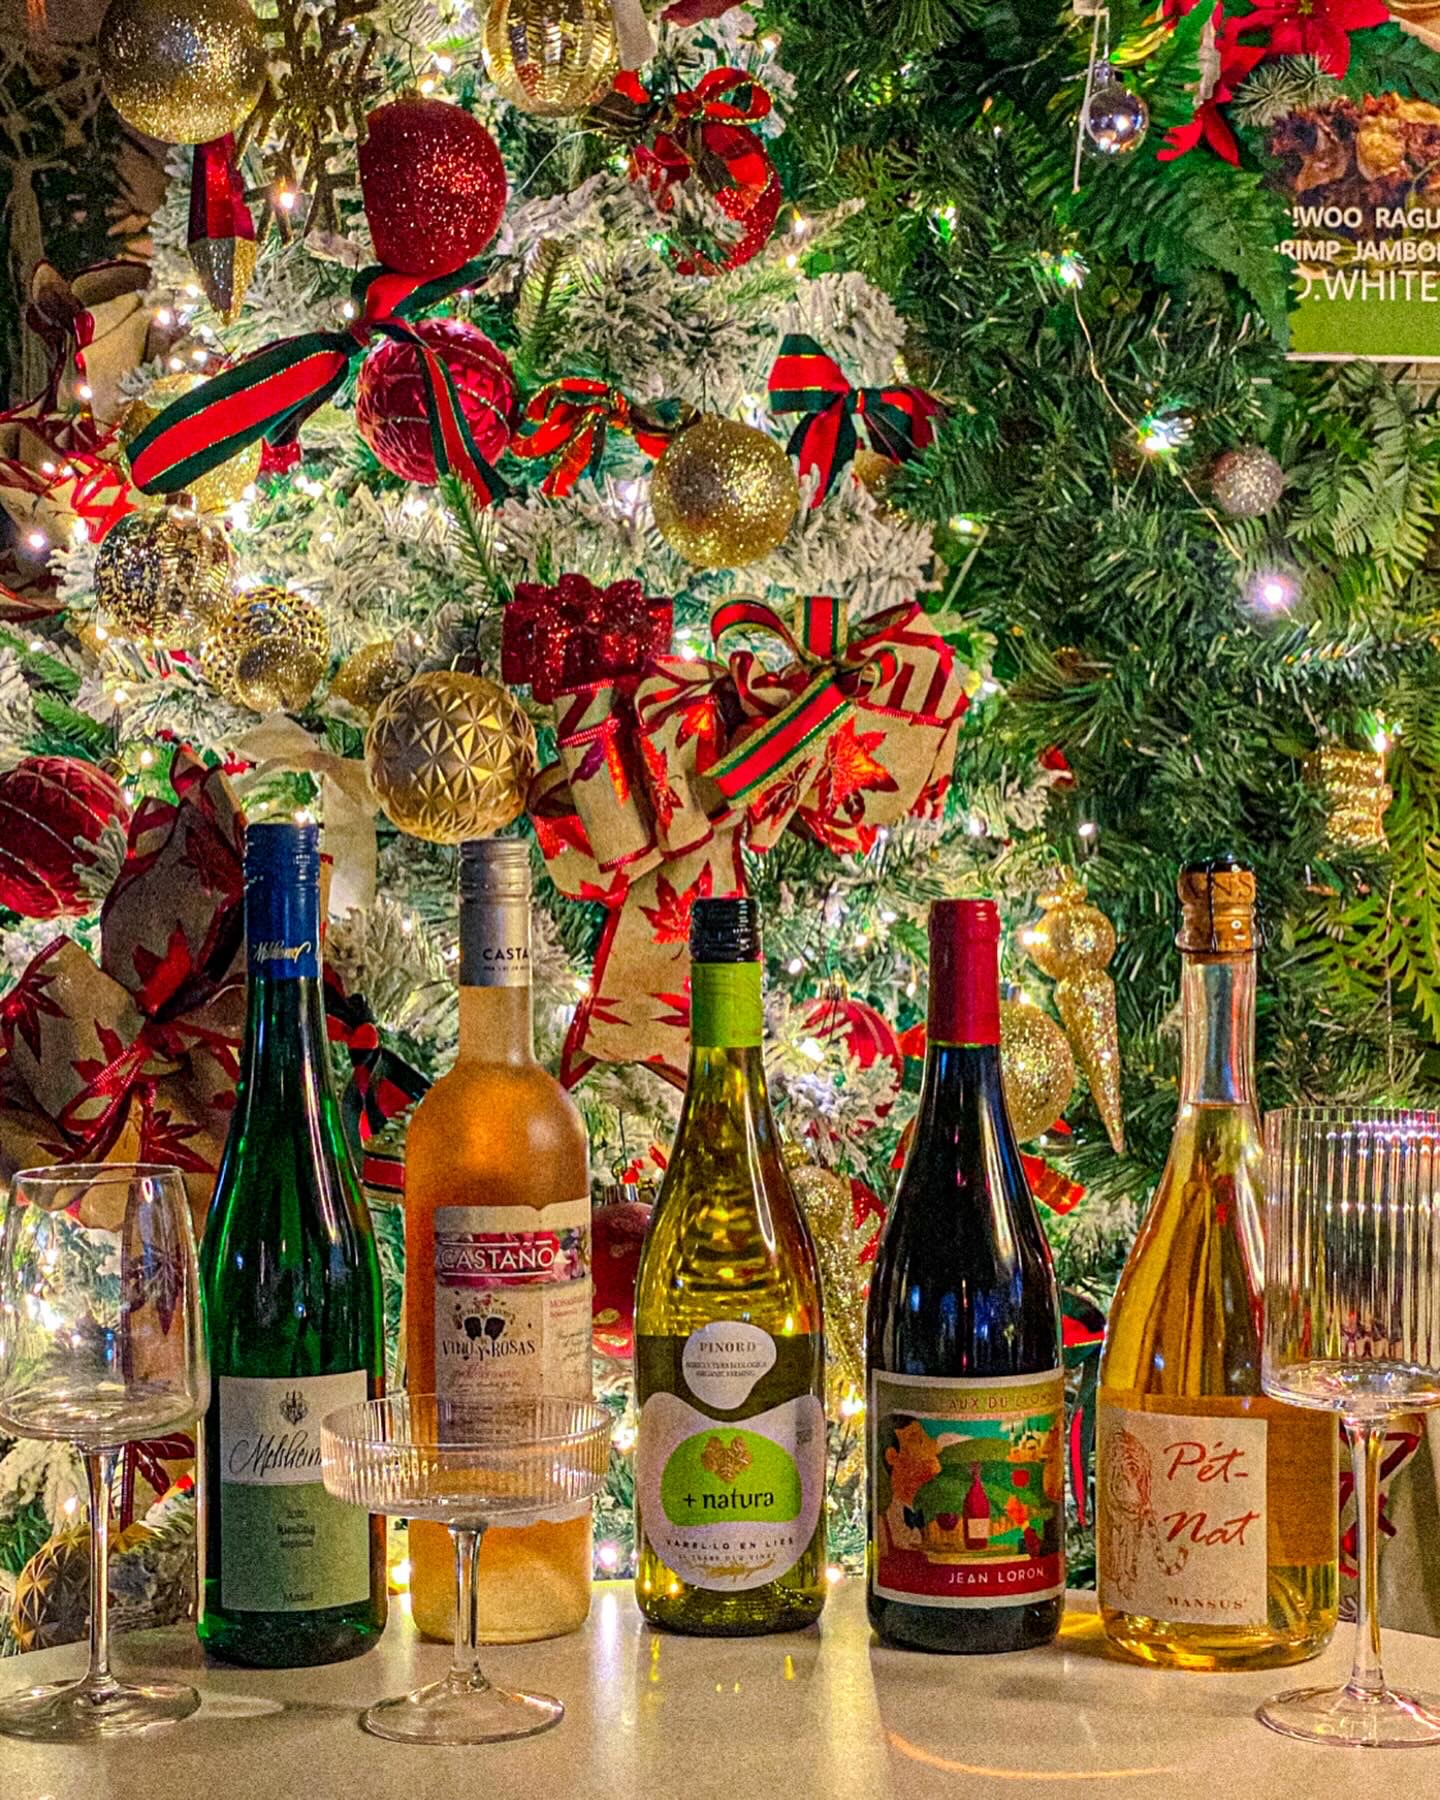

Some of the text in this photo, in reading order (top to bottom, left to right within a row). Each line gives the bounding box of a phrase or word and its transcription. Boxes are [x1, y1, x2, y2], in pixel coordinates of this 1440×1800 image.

[1375, 207, 1440, 229] RAGU
[1273, 240, 1440, 262] RIMP JAMBO
[483, 947, 528, 960] CASTA
[440, 1241, 555, 1269] CASTAÑO
[491, 1339, 536, 1357] ROSAS
[699, 1342, 756, 1353] PINORD
[988, 1397, 1009, 1409] DU
[703, 1489, 774, 1510] natura
[1163, 1510, 1259, 1546] Nat
[740, 1542, 756, 1550] EN
[765, 1537, 793, 1547] LIES
[949, 1568, 1044, 1584] JEAN LORON
